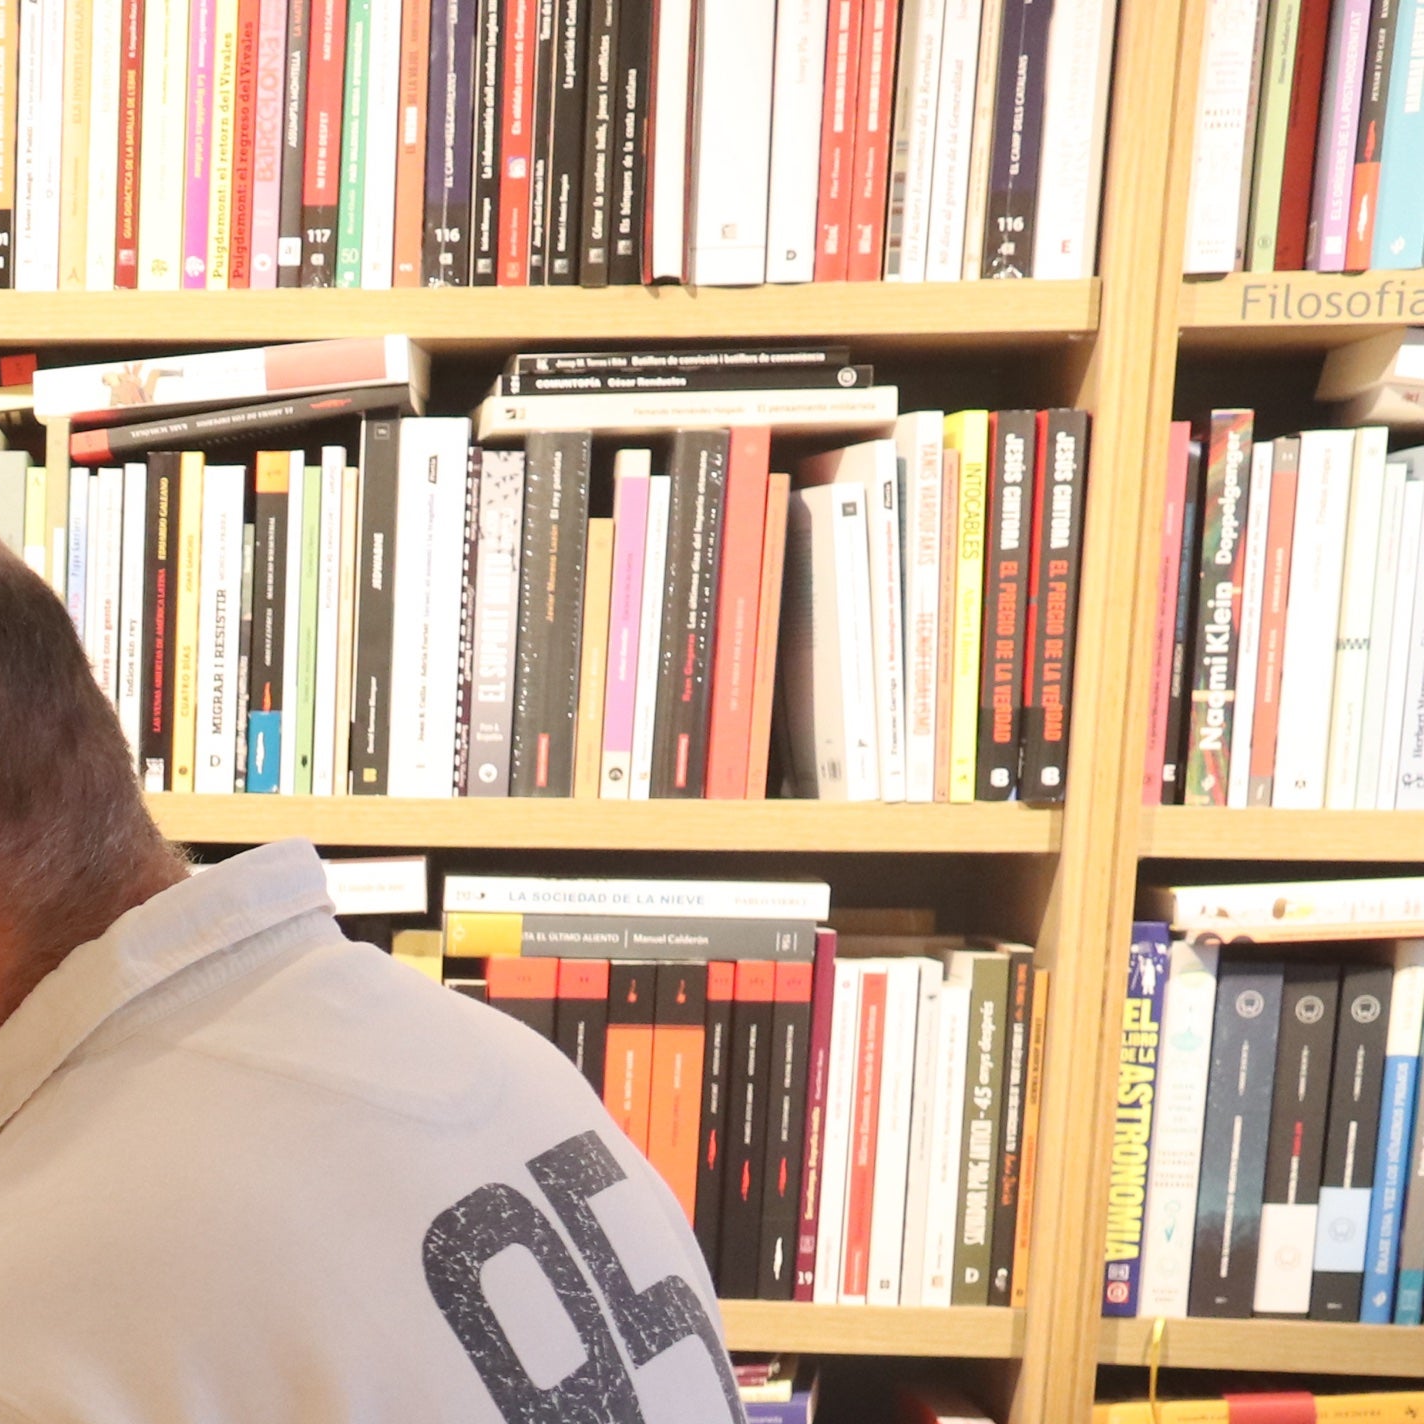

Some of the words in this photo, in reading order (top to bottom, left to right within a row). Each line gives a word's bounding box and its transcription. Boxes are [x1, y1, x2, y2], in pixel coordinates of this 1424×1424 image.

[241, 20, 254, 86] Vivales
[238, 116, 250, 165] regreso
[306, 228, 332, 245] 117
[434, 227, 461, 244] 116
[996, 215, 1025, 232] 116
[1241, 279, 1424, 321] Filosofia
[1004, 432, 1026, 484] JESÚS
[1054, 430, 1078, 483] JESÚS
[961, 461, 983, 561] INTOCABLES
[1214, 429, 1245, 566] Doppelganger
[999, 560, 1019, 578] EL
[1048, 559, 1069, 578] EL
[215, 588, 227, 659] RESISTIR
[996, 580, 1018, 637] PRECIO
[1046, 580, 1067, 636] PRECIO
[1204, 581, 1234, 655] Klein
[993, 662, 1013, 681] LA
[994, 639, 1015, 659] DE
[1042, 661, 1062, 681] LA
[1044, 638, 1064, 659] DE
[211, 672, 224, 735] MIGRAR
[992, 682, 1012, 743] VERDAD
[1041, 682, 1063, 742] VERDAD
[1198, 657, 1229, 751] Naomi
[508, 890, 527, 903] LA
[532, 891, 607, 905] SOCIEDAD
[612, 892, 632, 905] DE
[636, 893, 656, 905] LA
[660, 893, 706, 906] NIEVE
[632, 931, 666, 945] Manuel
[1122, 998, 1160, 1031] EL
